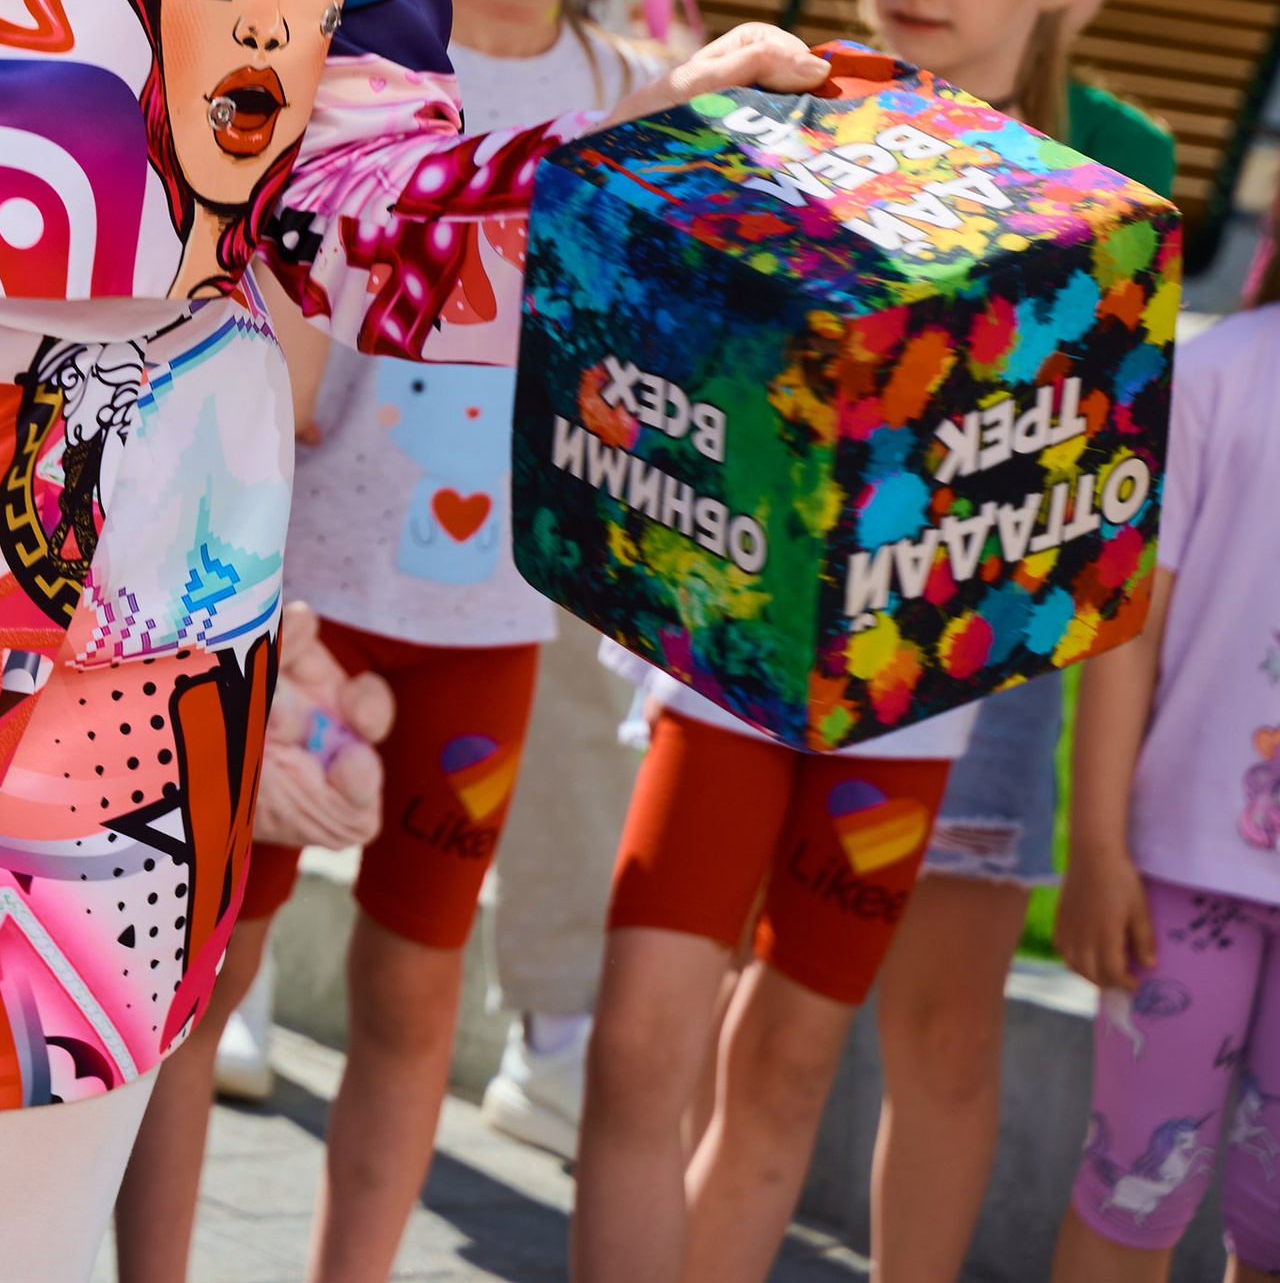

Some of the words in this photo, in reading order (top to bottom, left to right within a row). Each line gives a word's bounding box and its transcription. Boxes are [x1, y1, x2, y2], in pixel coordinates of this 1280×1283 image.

[741, 124, 955, 207] ВСЕМ
[840, 167, 1014, 256] ДАЙ
[599, 354, 727, 463] ВСЕХ
[934, 377, 1087, 484] ТРЕК
[552, 414, 767, 574] ОБНИМИ
[844, 458, 1150, 632] ОТГАДАЙ
